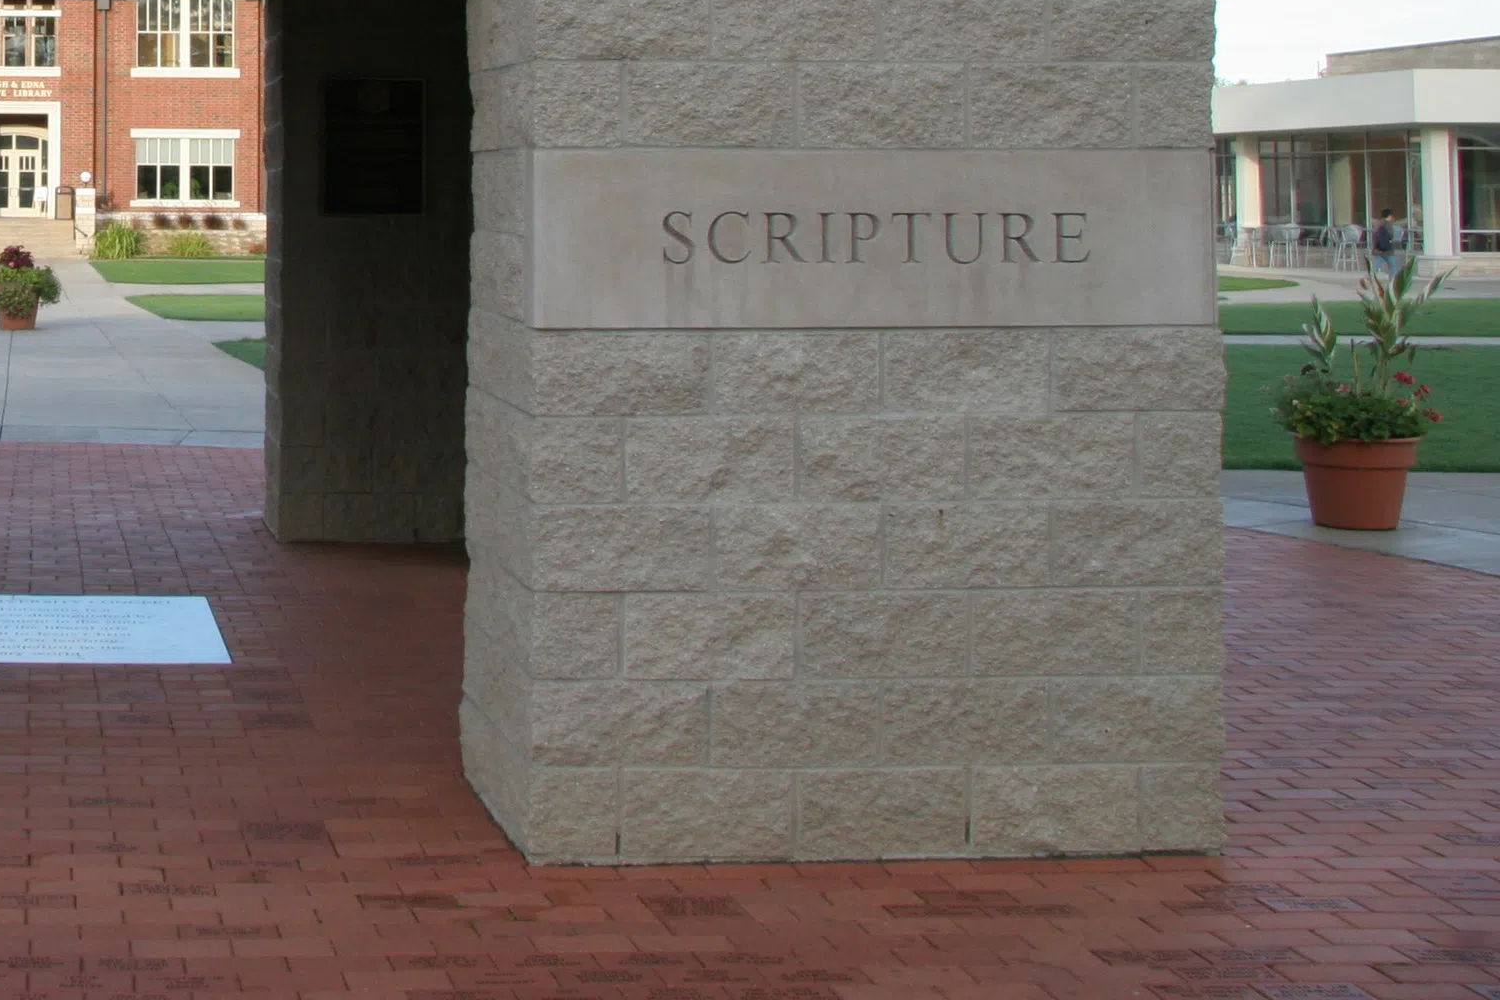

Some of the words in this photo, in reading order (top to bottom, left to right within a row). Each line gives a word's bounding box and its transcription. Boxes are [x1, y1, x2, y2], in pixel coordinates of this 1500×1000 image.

[21, 81, 45, 89] EDNA
[13, 89, 52, 97] LIBRARY
[661, 211, 1092, 265] SCRIPTURE
